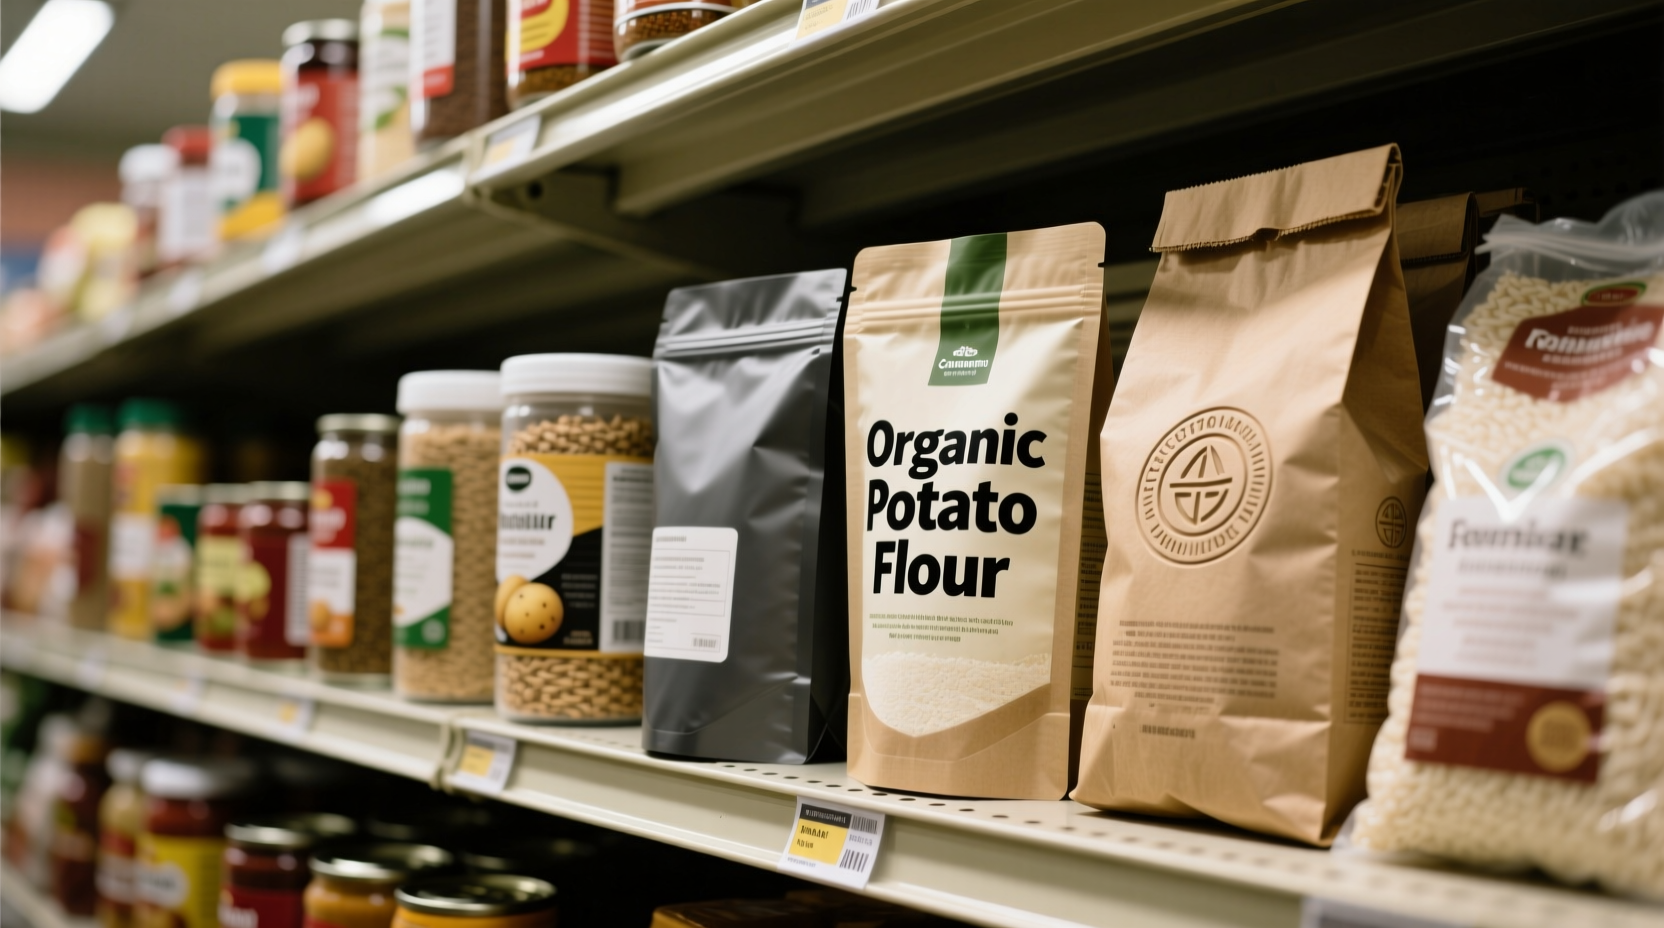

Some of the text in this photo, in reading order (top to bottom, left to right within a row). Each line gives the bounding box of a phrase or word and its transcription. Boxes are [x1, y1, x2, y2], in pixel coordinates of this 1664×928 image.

[867, 412, 1047, 479] Organic
[867, 479, 1037, 534] Potato
[873, 539, 1010, 598] Flour
